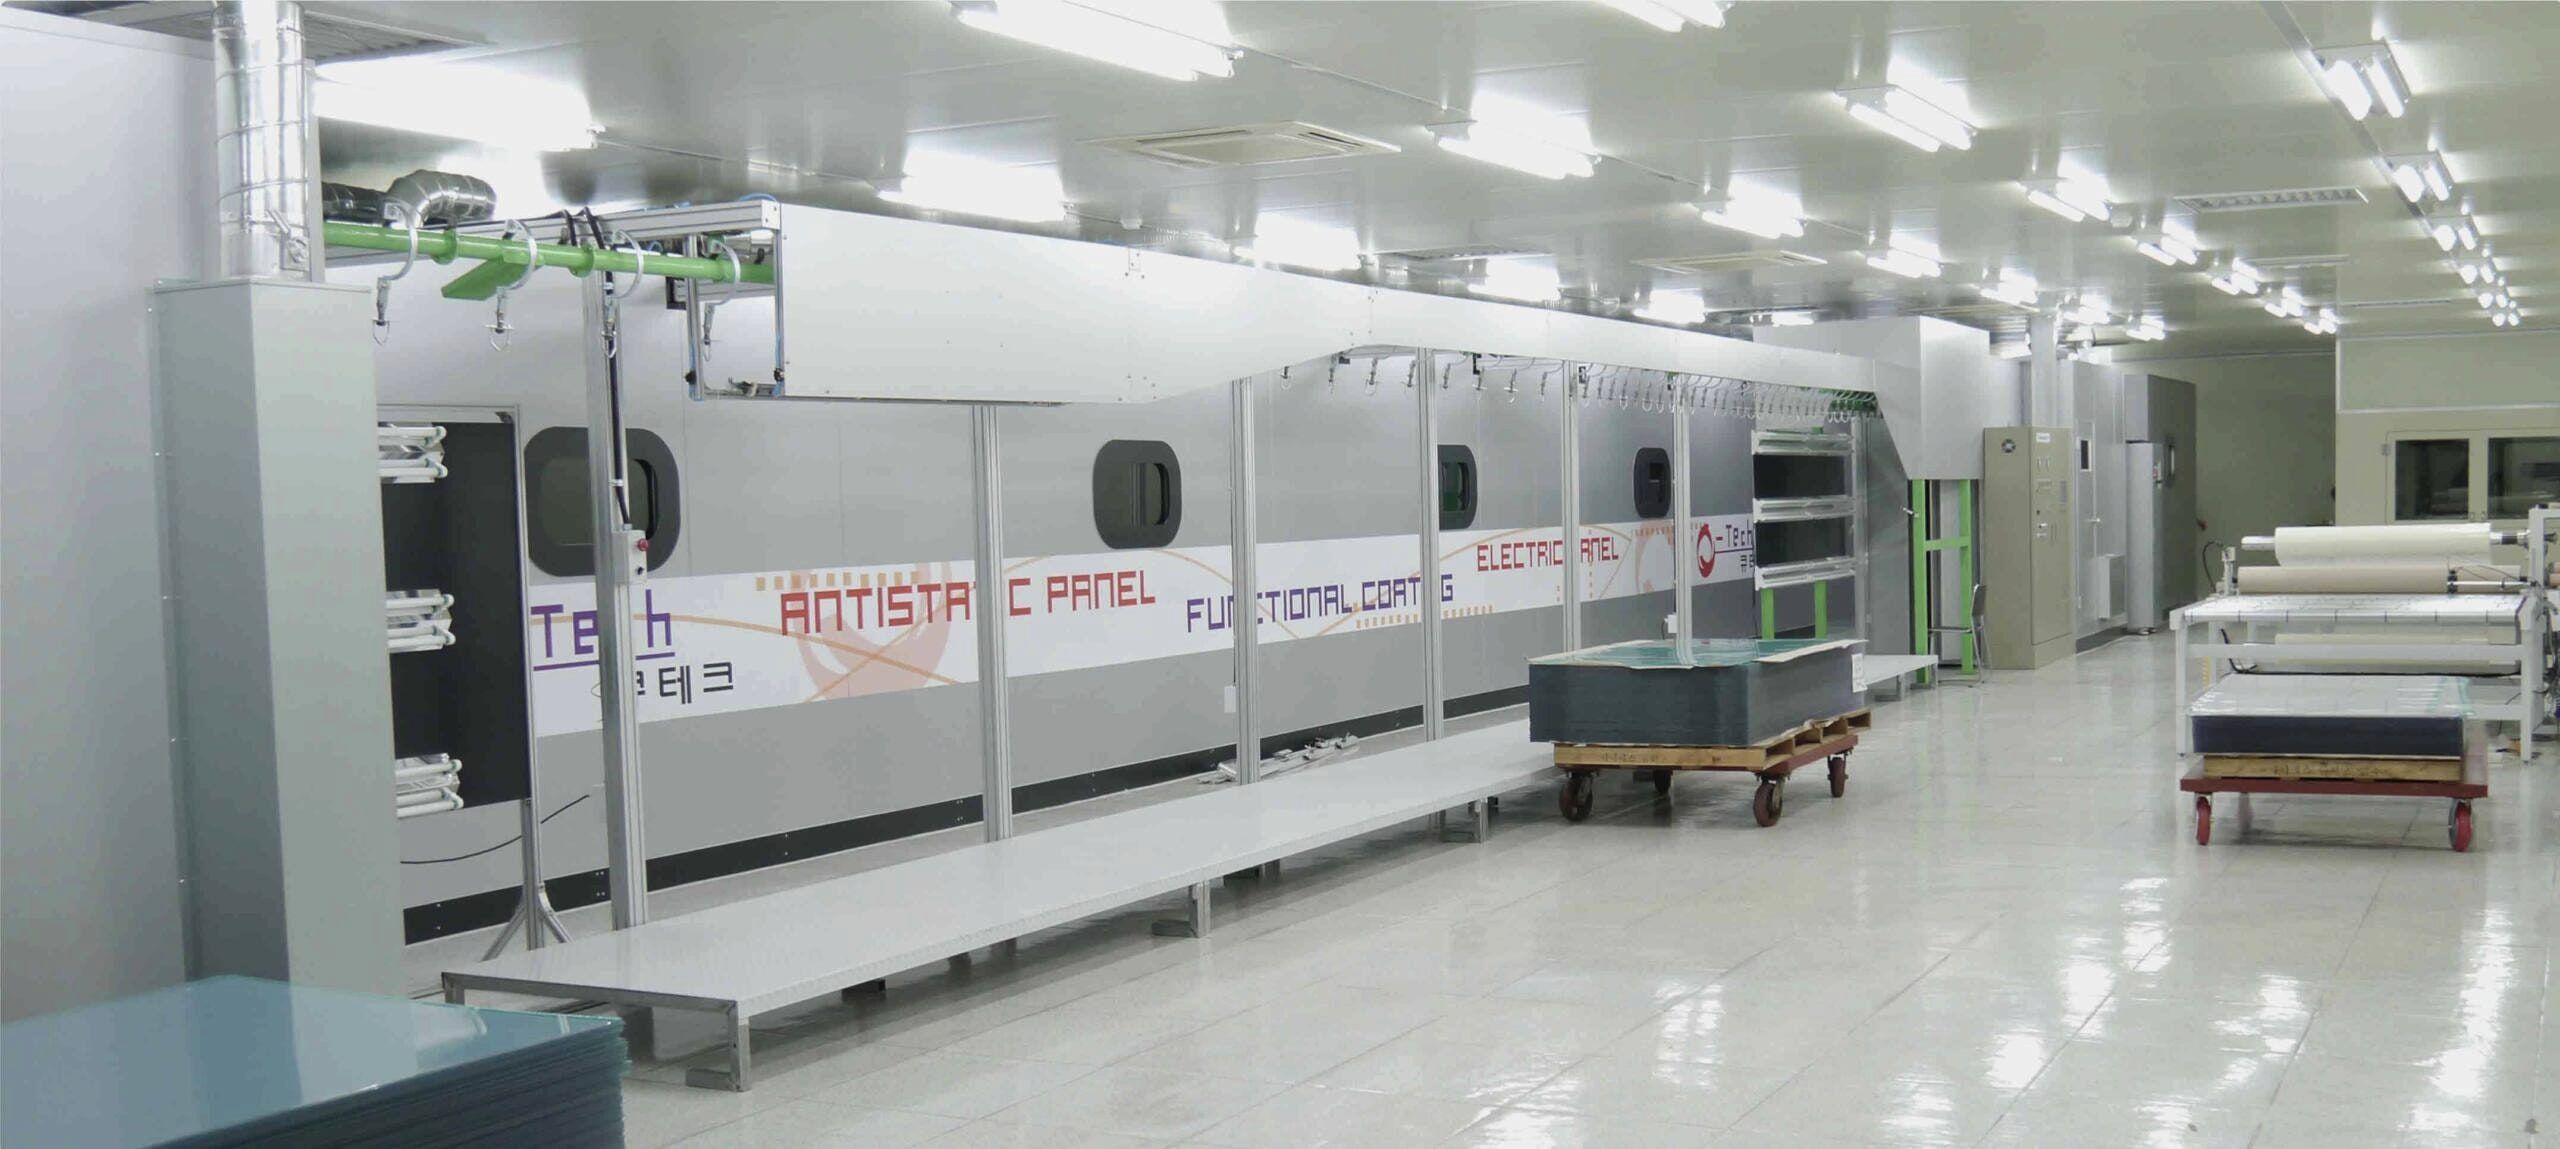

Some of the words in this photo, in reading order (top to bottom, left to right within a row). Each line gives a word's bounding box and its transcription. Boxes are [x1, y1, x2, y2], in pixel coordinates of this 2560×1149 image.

[1477, 540, 1563, 571] ELECTRIC
[1580, 536, 1619, 563] ANEL
[530, 588, 672, 658] Teh
[780, 577, 1031, 636] ANTISTAC
[1047, 570, 1155, 614] PANEL
[1187, 584, 1352, 633] FUTIONAL
[1361, 574, 1453, 612] COATG
